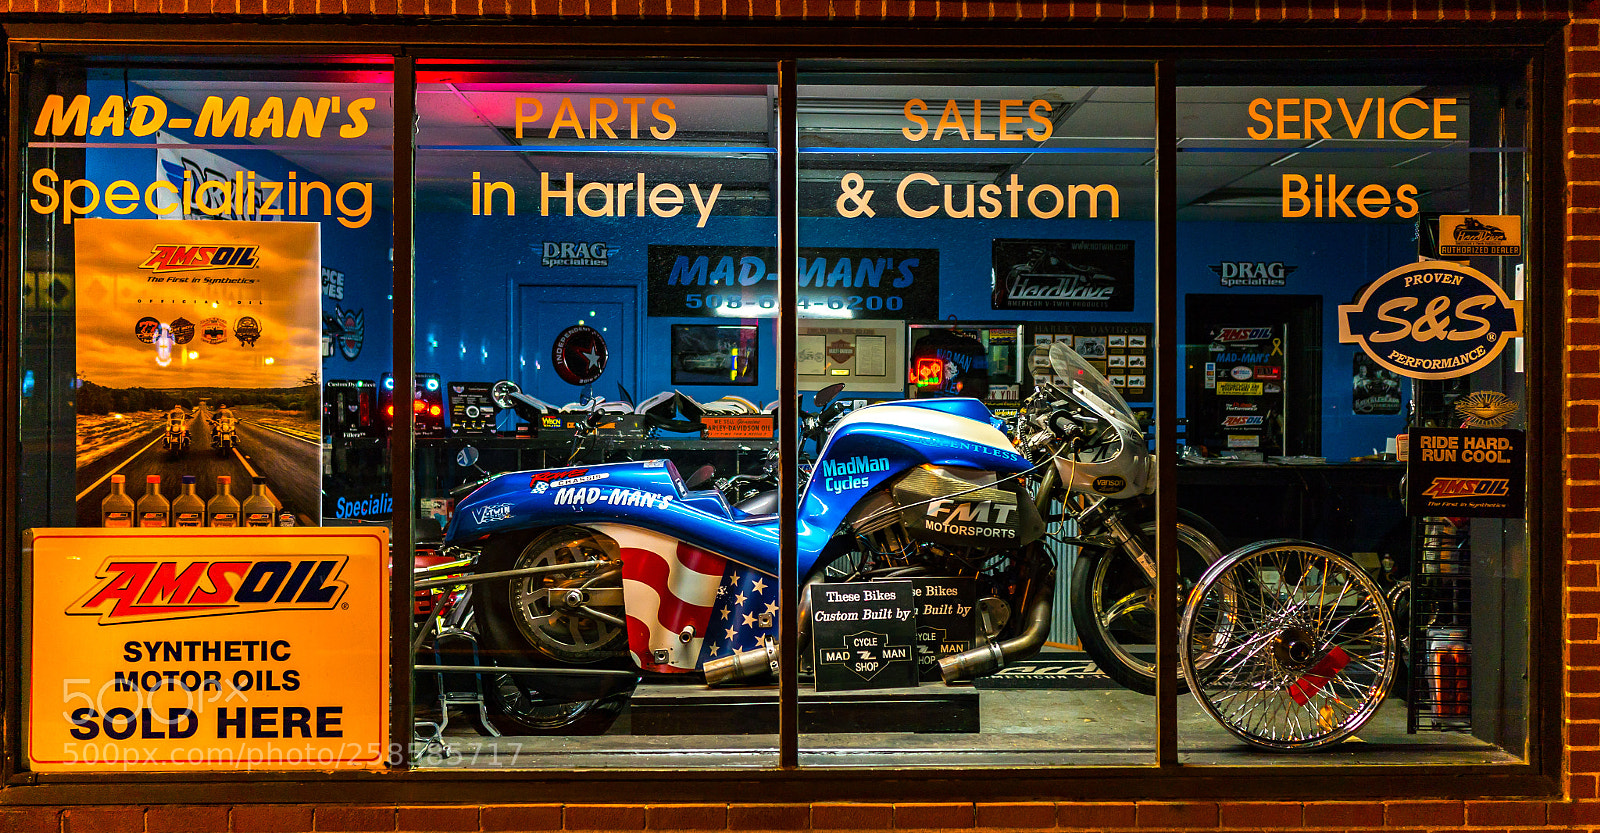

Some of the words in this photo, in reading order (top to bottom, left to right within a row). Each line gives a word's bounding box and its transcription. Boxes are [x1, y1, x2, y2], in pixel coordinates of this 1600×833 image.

[34, 95, 375, 138] MAD-MAN'S
[515, 97, 677, 140] PARTS
[902, 99, 1053, 141] SALES
[1247, 97, 1457, 140] SERVICE
[30, 168, 373, 229] Specializing
[472, 172, 515, 216] in
[540, 172, 723, 228] Harley
[836, 173, 876, 219] &
[896, 173, 1120, 219] Custom
[1282, 174, 1419, 219] Bikes
[141, 245, 258, 272] AMSOIL
[543, 242, 608, 258] DRAG
[542, 258, 608, 268] Specialties
[668, 255, 919, 288] MAD-MAN'S
[1222, 262, 1285, 278] DRAG
[203, 277, 255, 285] Synthetics
[321, 267, 344, 287] NCE
[1221, 278, 1285, 287] Specialties
[1404, 273, 1465, 287] PROVEN
[1008, 274, 1115, 300] HardDrive
[685, 294, 903, 311] 508-64-6200
[1369, 295, 1497, 343] S&S
[1215, 328, 1271, 342] AMSOIL
[1216, 353, 1270, 363] MAD-MAN'S
[1387, 345, 1486, 369] PERFORMANCE
[1221, 416, 1263, 426] AMSOIL
[1420, 436, 1459, 449] RIDE
[1464, 437, 1514, 450] HARD.
[1422, 449, 1457, 462] RUN
[1461, 450, 1511, 463] COOL.
[823, 456, 889, 477] MadMan
[825, 476, 869, 494] Cycles
[1424, 478, 1508, 498] AMSOIL
[336, 493, 393, 519] Specializ
[554, 488, 673, 510] MAD-MAN'S
[927, 499, 1017, 525] FMT
[925, 520, 1015, 538] MOTORSPORTS
[76, 558, 344, 621] AMSOIL
[826, 592, 860, 602] These
[863, 590, 896, 601] Bikes
[926, 586, 957, 596] Bikes
[815, 611, 858, 621] Custom
[862, 609, 892, 620] Built
[896, 608, 911, 621] by
[923, 604, 953, 615] Built
[956, 604, 972, 617] by
[123, 641, 291, 662] SYNTHETIC
[854, 638, 877, 647] CYCLE
[940, 644, 964, 653] MAN
[826, 652, 850, 661] MAD
[882, 649, 905, 658] MAN
[918, 656, 936, 664] HOP
[855, 662, 878, 671] SHOP
[115, 671, 222, 692] MOTOR
[233, 671, 301, 692] OILS
[69, 707, 199, 740] SOLD
[217, 706, 343, 738] HERE
